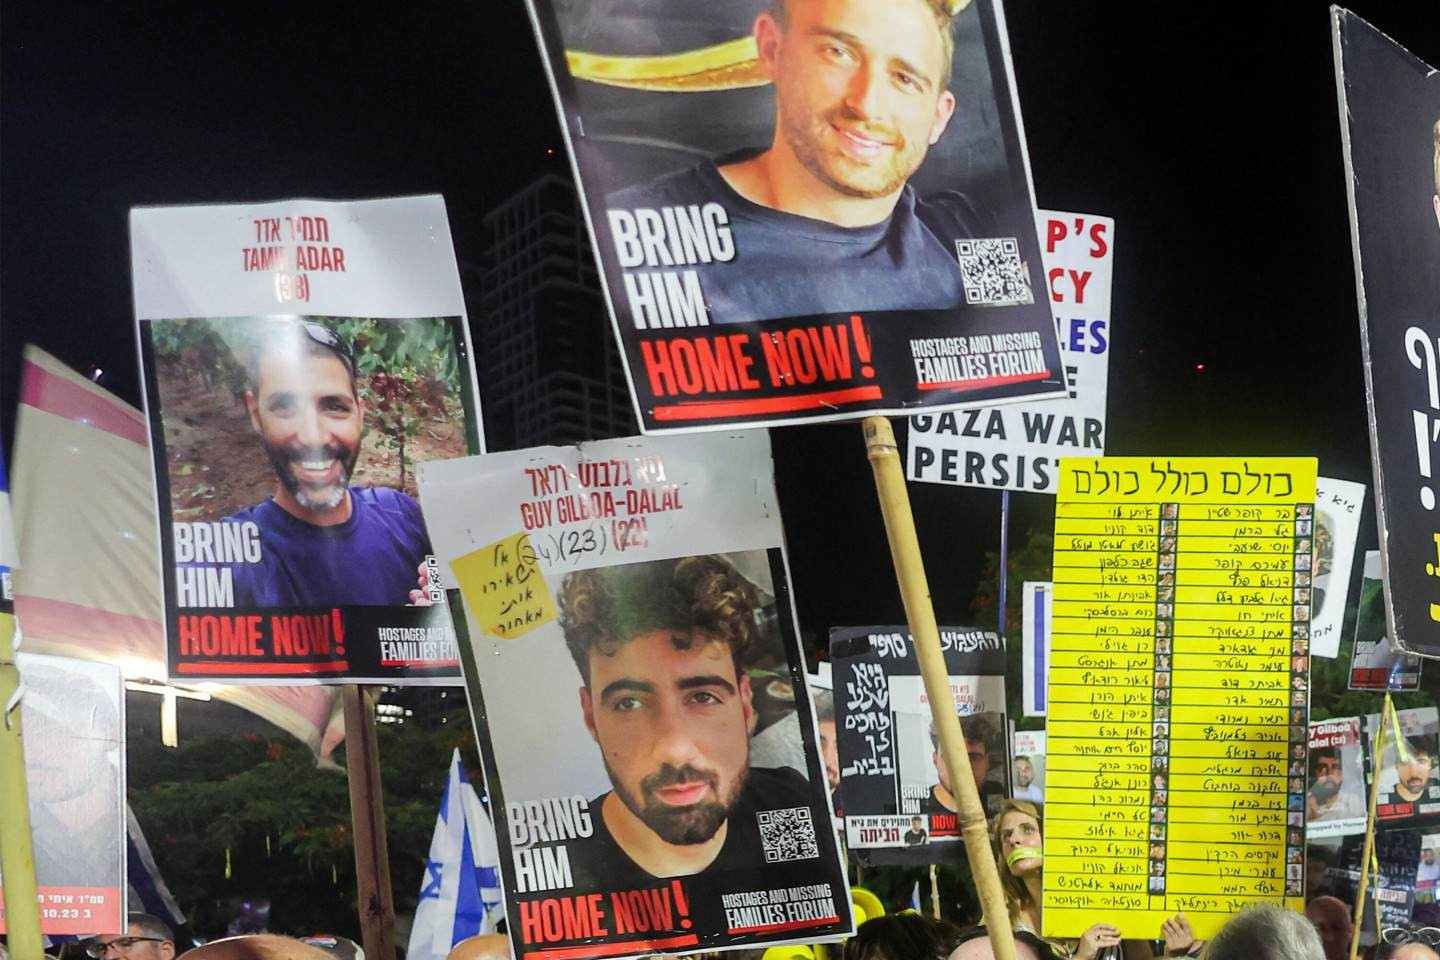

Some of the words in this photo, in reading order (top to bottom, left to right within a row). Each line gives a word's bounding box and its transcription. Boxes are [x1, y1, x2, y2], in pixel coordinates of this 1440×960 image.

[254, 218, 281, 242] אדר
[607, 203, 735, 268] BRING
[296, 246, 346, 271] ADAR
[623, 270, 710, 330] HIM
[640, 334, 755, 397] HOME
[760, 315, 876, 388] NOW!
[910, 337, 968, 357] HOSTAGES
[969, 335, 992, 351] AND
[993, 331, 1042, 351] MISSING
[913, 355, 988, 384] FAMILIES
[990, 349, 1048, 379] FORUM
[911, 408, 1007, 440] GAZA
[1022, 411, 1103, 449] WAR
[914, 446, 1060, 490] PERSIS
[1072, 461, 1140, 495] כולם
[1150, 461, 1208, 496] כולל
[1221, 462, 1293, 497] כולם
[520, 500, 552, 531] GUY
[174, 522, 262, 564] BRING
[177, 567, 235, 608] HIM
[178, 615, 264, 656] HOME
[271, 608, 346, 655] NOW!
[378, 627, 425, 641] HOSTAGES
[380, 641, 437, 661] FAMILIES
[852, 663, 887, 689] גיא
[507, 796, 595, 847] BRING
[851, 818, 864, 829] גיא
[901, 799, 921, 815] HIM
[860, 827, 900, 844] הביתה
[514, 845, 575, 893] HIM
[519, 892, 610, 945] HOME
[611, 880, 693, 935] NOW!
[721, 890, 770, 909] HOSTAGES
[771, 888, 787, 905] AND
[789, 884, 833, 902] MISSING
[725, 904, 786, 930] FAMILIES
[788, 898, 837, 922] FORUM
